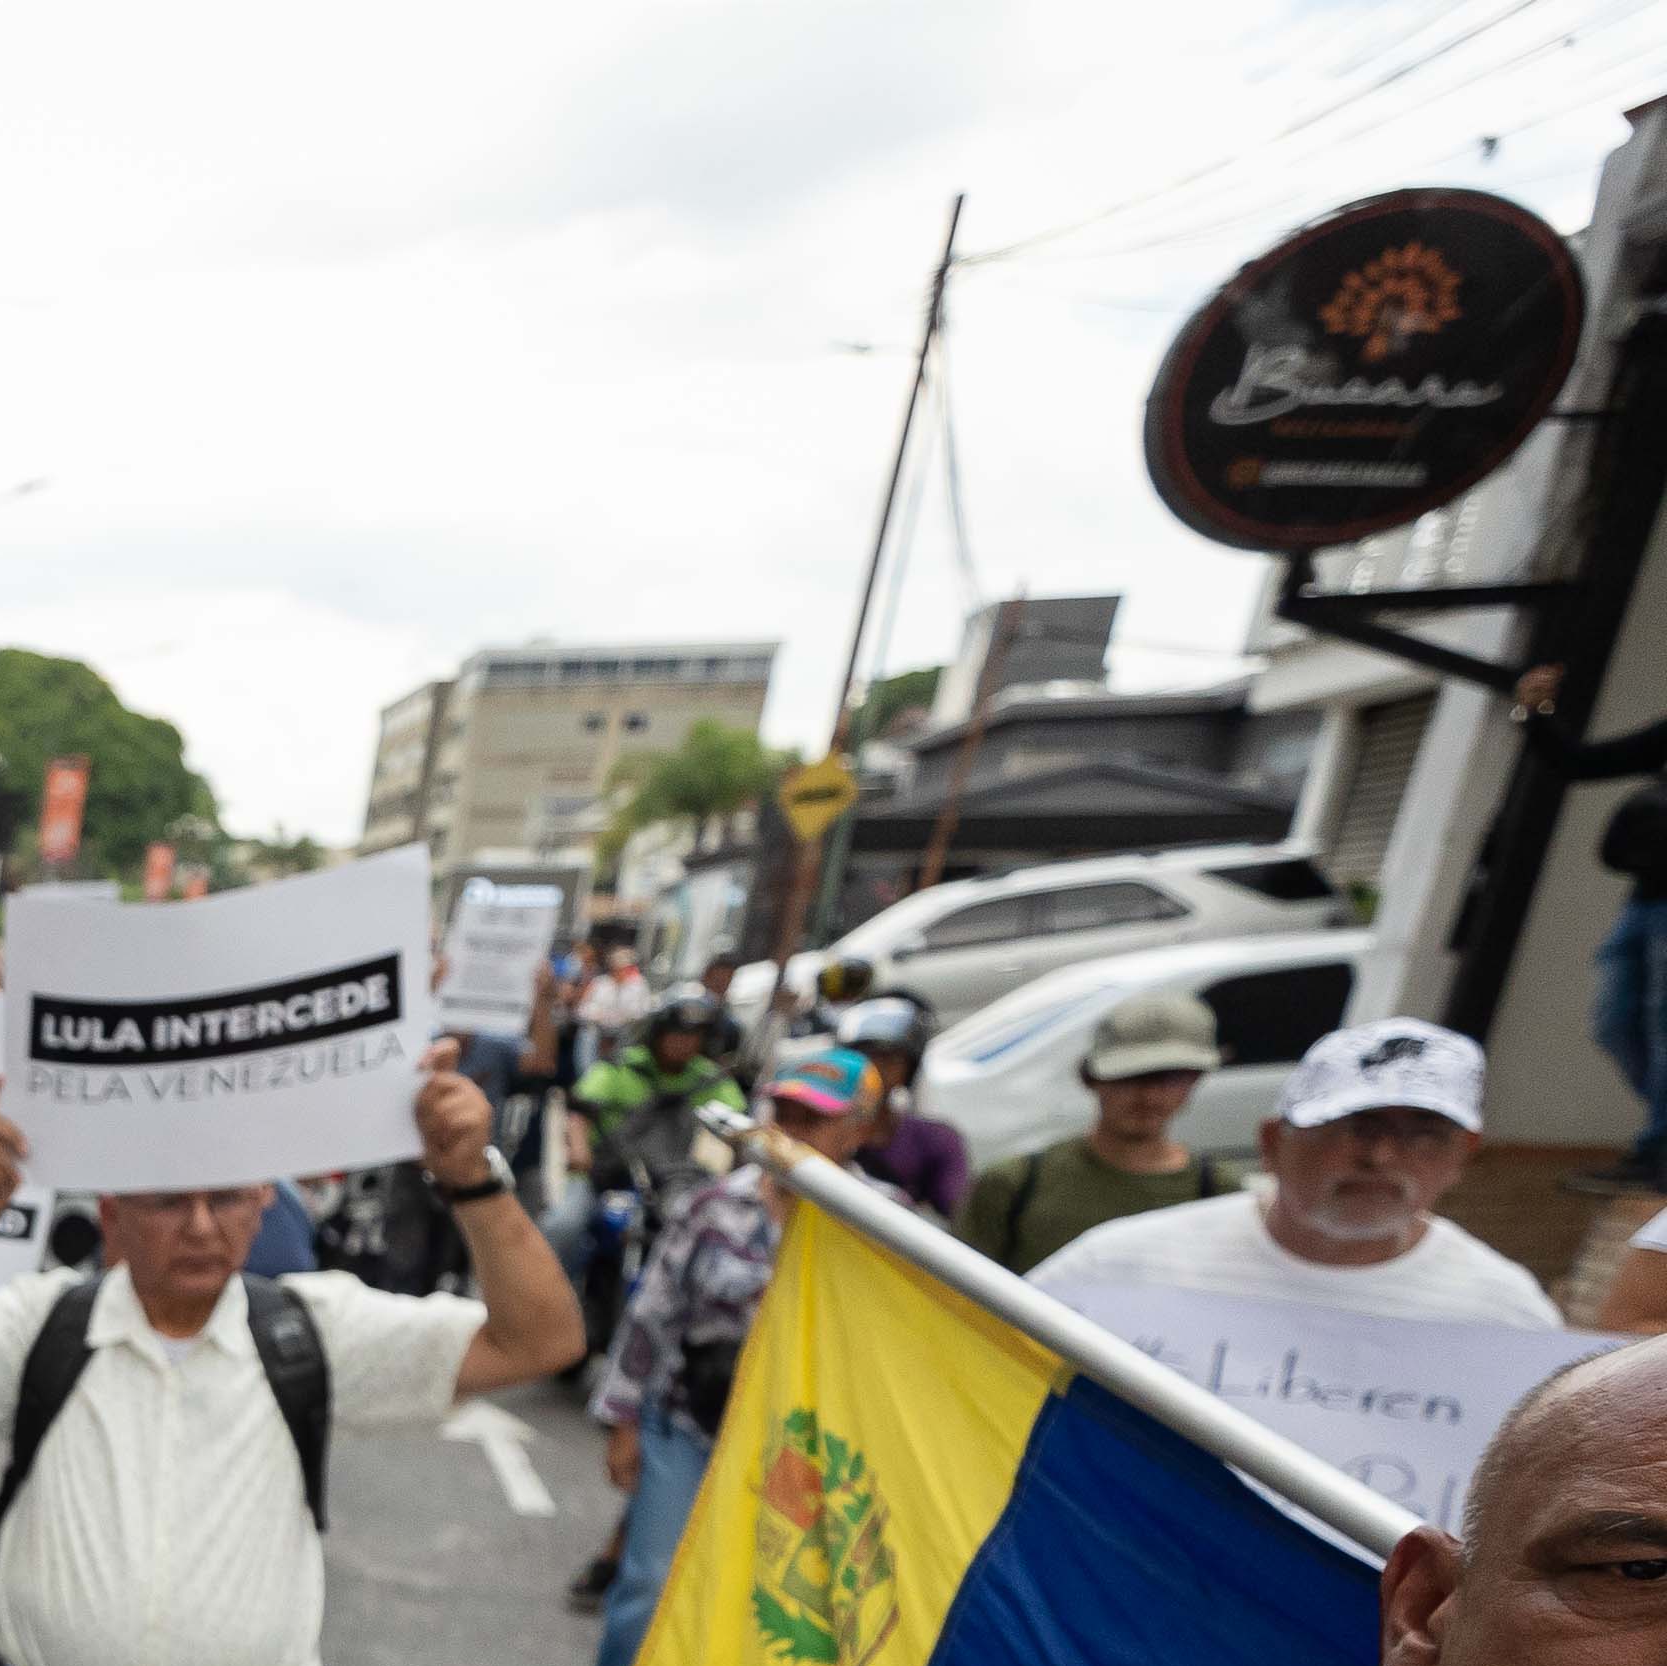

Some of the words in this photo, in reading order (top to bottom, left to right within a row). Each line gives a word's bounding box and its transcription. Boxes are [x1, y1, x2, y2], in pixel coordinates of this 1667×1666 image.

[39, 1008, 142, 1054] LULA
[150, 972, 390, 1048] INTERCEDE
[27, 1064, 132, 1107] PELA
[141, 1030, 406, 1106] VENEZUELA
